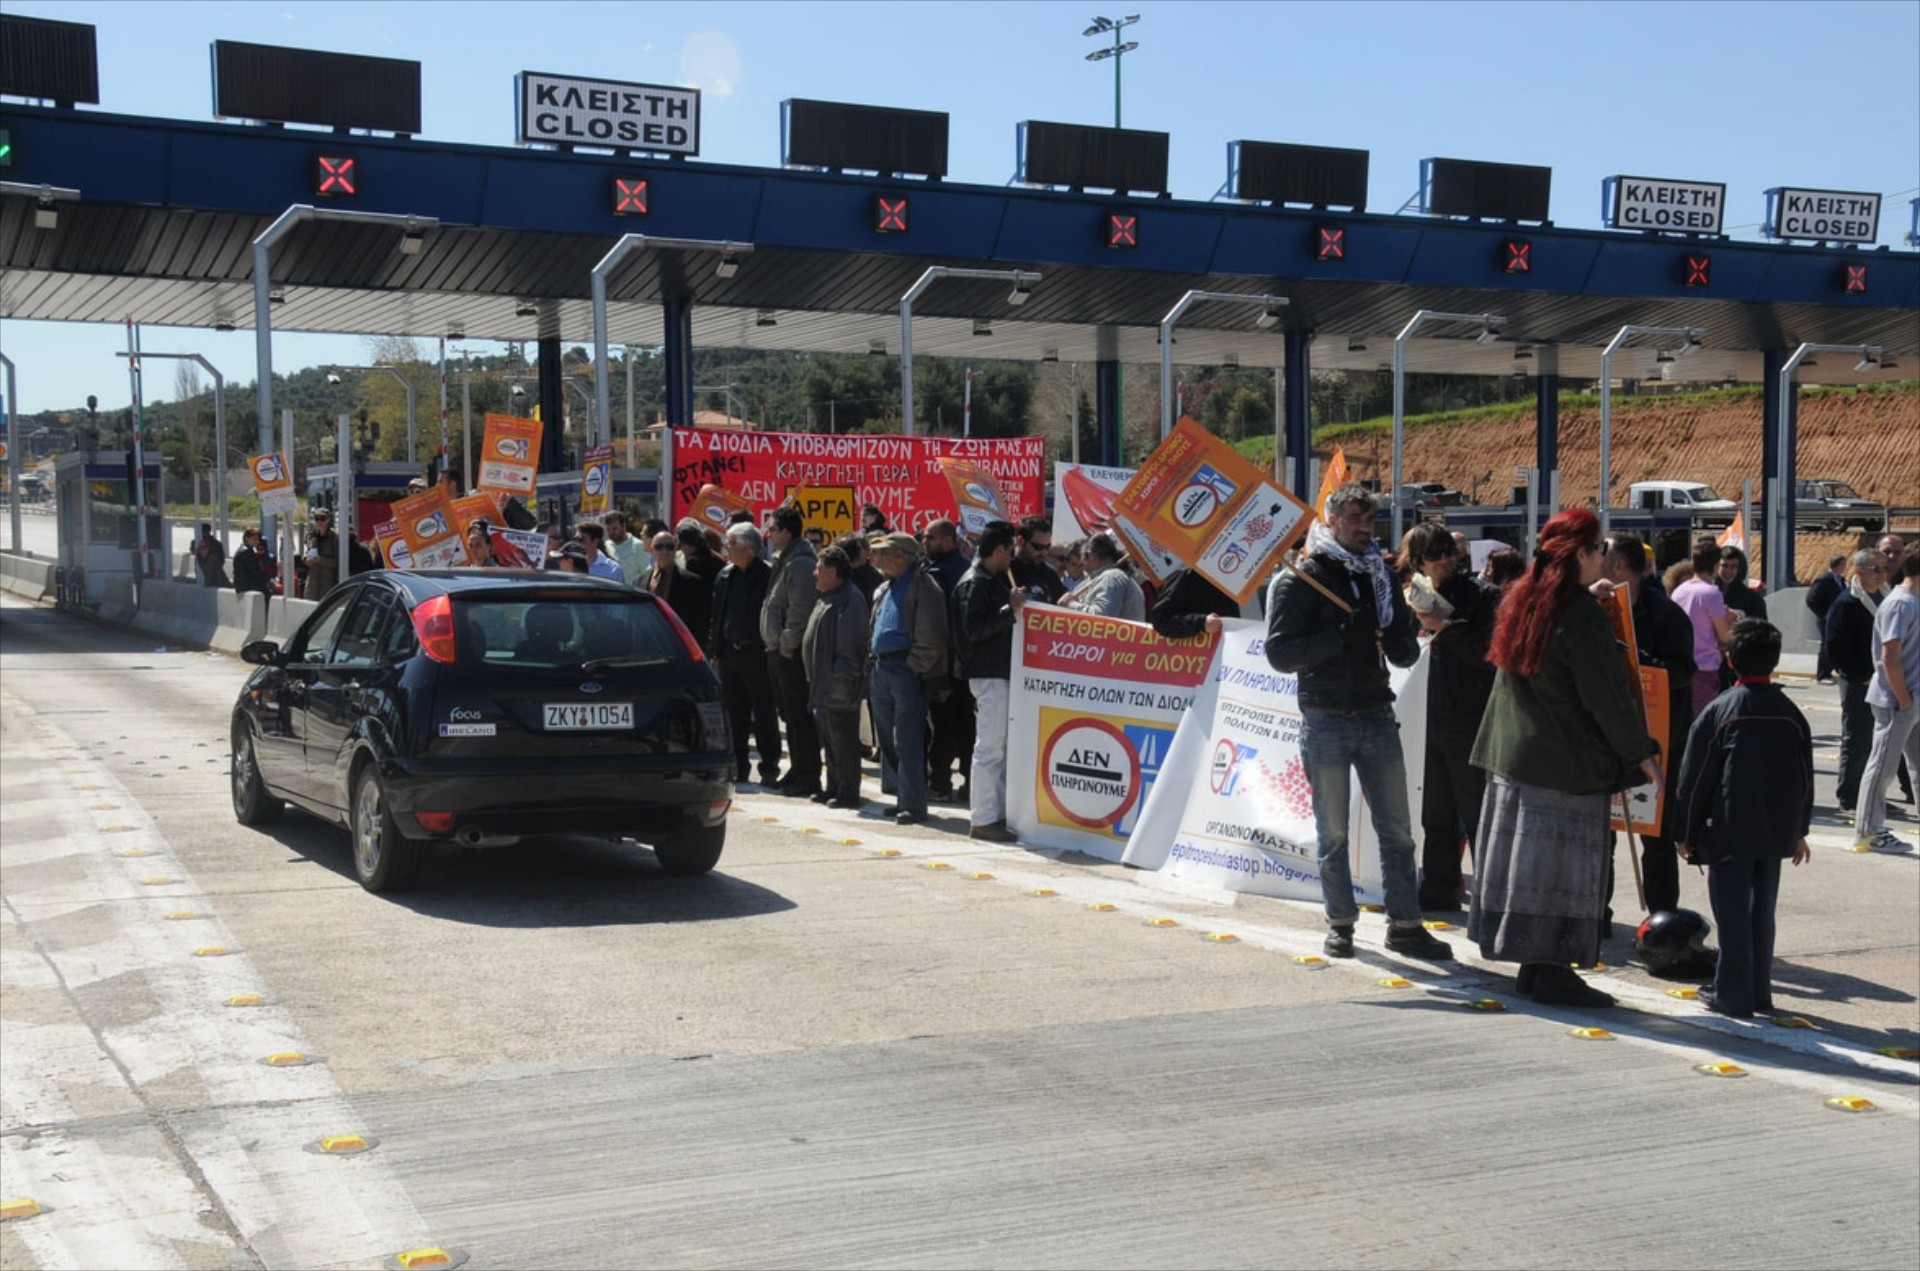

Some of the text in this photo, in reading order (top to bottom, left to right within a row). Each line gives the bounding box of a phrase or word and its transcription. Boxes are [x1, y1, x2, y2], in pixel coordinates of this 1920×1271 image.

[536, 84, 688, 120] ΚΛΕΙΣΤΗ
[535, 113, 688, 146] CLOSED
[1626, 184, 1717, 208] ΚΛΕΙΣΤΗ
[1788, 196, 1873, 216] ΚΛΕΙΣΤΗ
[1623, 206, 1715, 229] CLOSED
[1786, 217, 1870, 237] CLOSED
[675, 431, 1044, 460] ΤΑ ΔΙΟΔΙΑ ΥΠΟΒΑΘΜΙΖΟΥΝ ΤΗ ΖΩΗ ΜΑΣ ΚΑΙ
[776, 460, 866, 484] ΚΑΤΑΡΓΗΣΗ
[740, 480, 776, 502] ΔΕΝ
[792, 500, 851, 520] ΑΡΓΑ
[1027, 613, 1137, 643] ΕΛΕΥΘΕΡΟΙ
[1047, 641, 1105, 663] ΧΩΡΟΙ
[1110, 651, 1137, 667] για
[1144, 653, 1207, 675] ΟΛΟΥΣ
[1023, 676, 1086, 699] ΚΑΤΑΡΓΗΣΗ
[1087, 686, 1125, 706] ΟΛΩΝ
[1128, 691, 1155, 708] ΤΩΝ
[590, 705, 630, 725] 1054
[1220, 702, 1276, 725] ΕΠΙΤΡΟΠΕΣ
[1223, 716, 1272, 738] ΠΟΛΙΤΩΝ
[1067, 748, 1110, 769] ΔΕΝ
[1051, 774, 1127, 799] ΠΛΗΡΩΝΟΥΜΕ
[1205, 820, 1310, 858] ΟΡΓΑΝΩΝΟΜΑΣΤΕ
